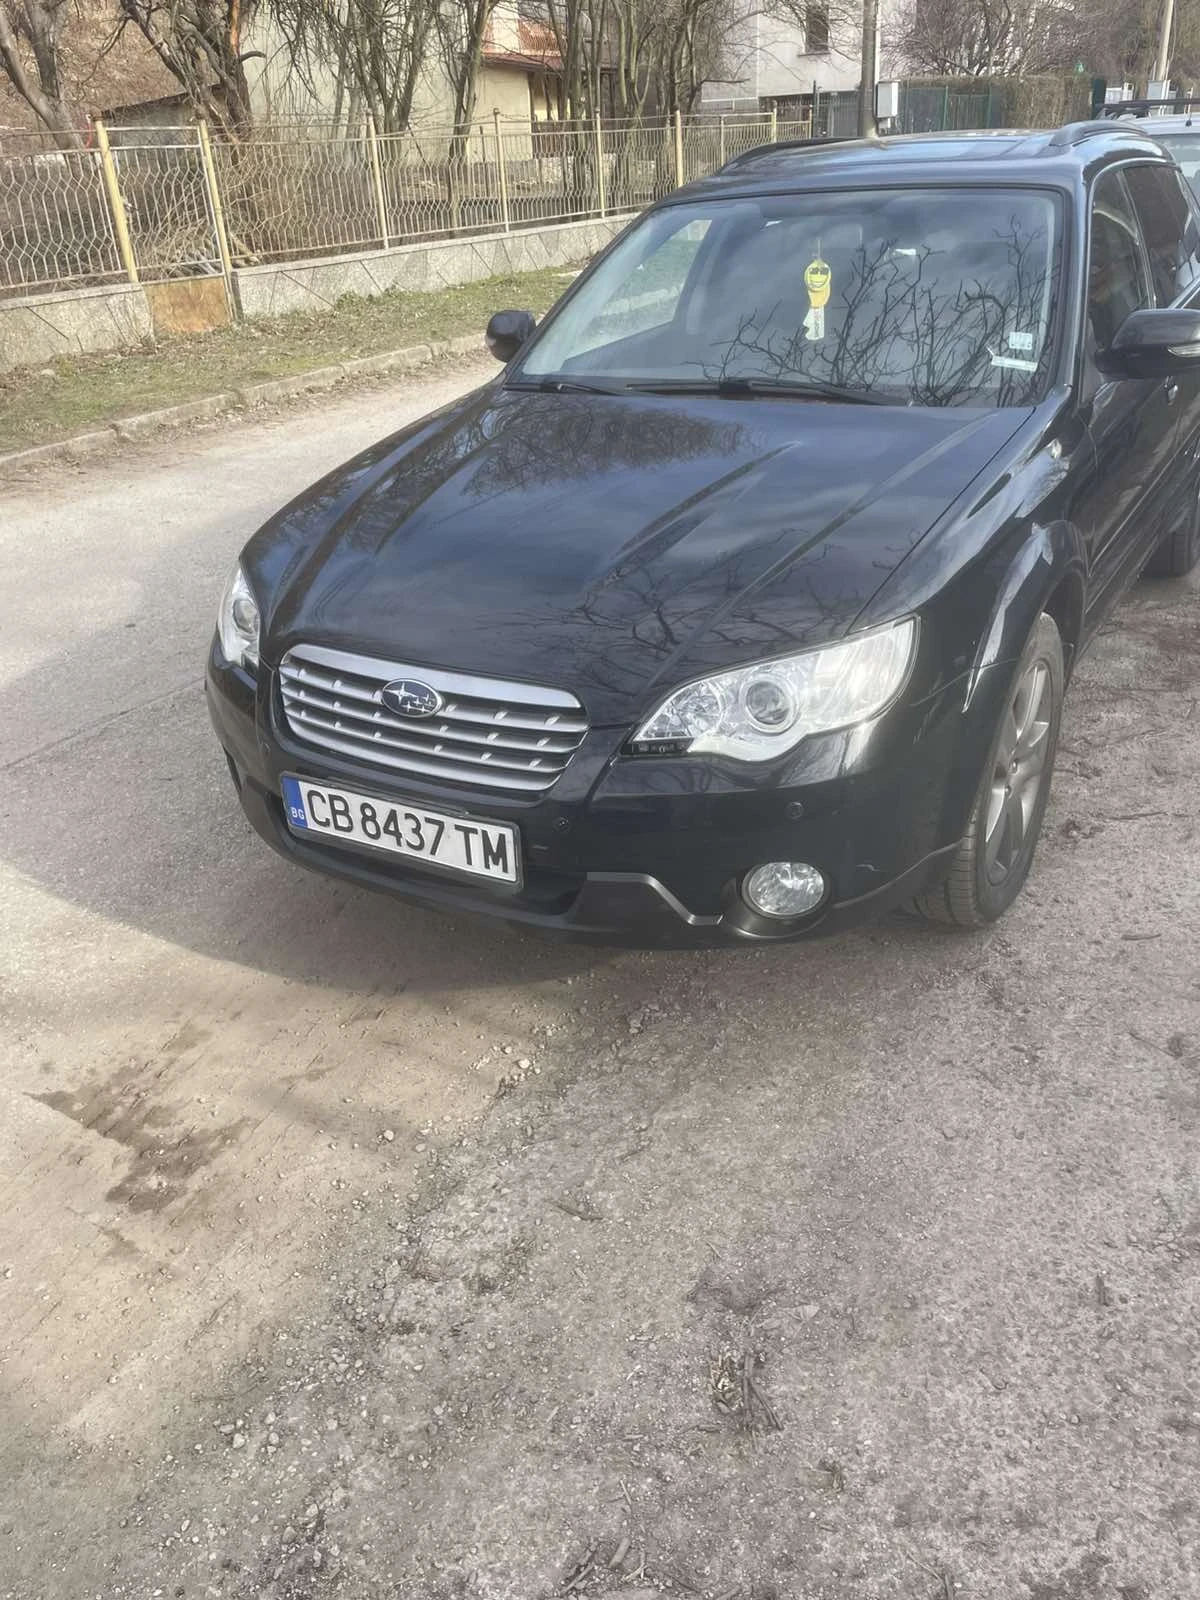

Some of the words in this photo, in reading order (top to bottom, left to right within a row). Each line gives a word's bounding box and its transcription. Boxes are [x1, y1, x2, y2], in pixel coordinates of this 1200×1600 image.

[290, 806, 304, 820] BG
[307, 789, 353, 832] CB
[360, 803, 445, 855] 8437
[454, 824, 508, 873] TM
